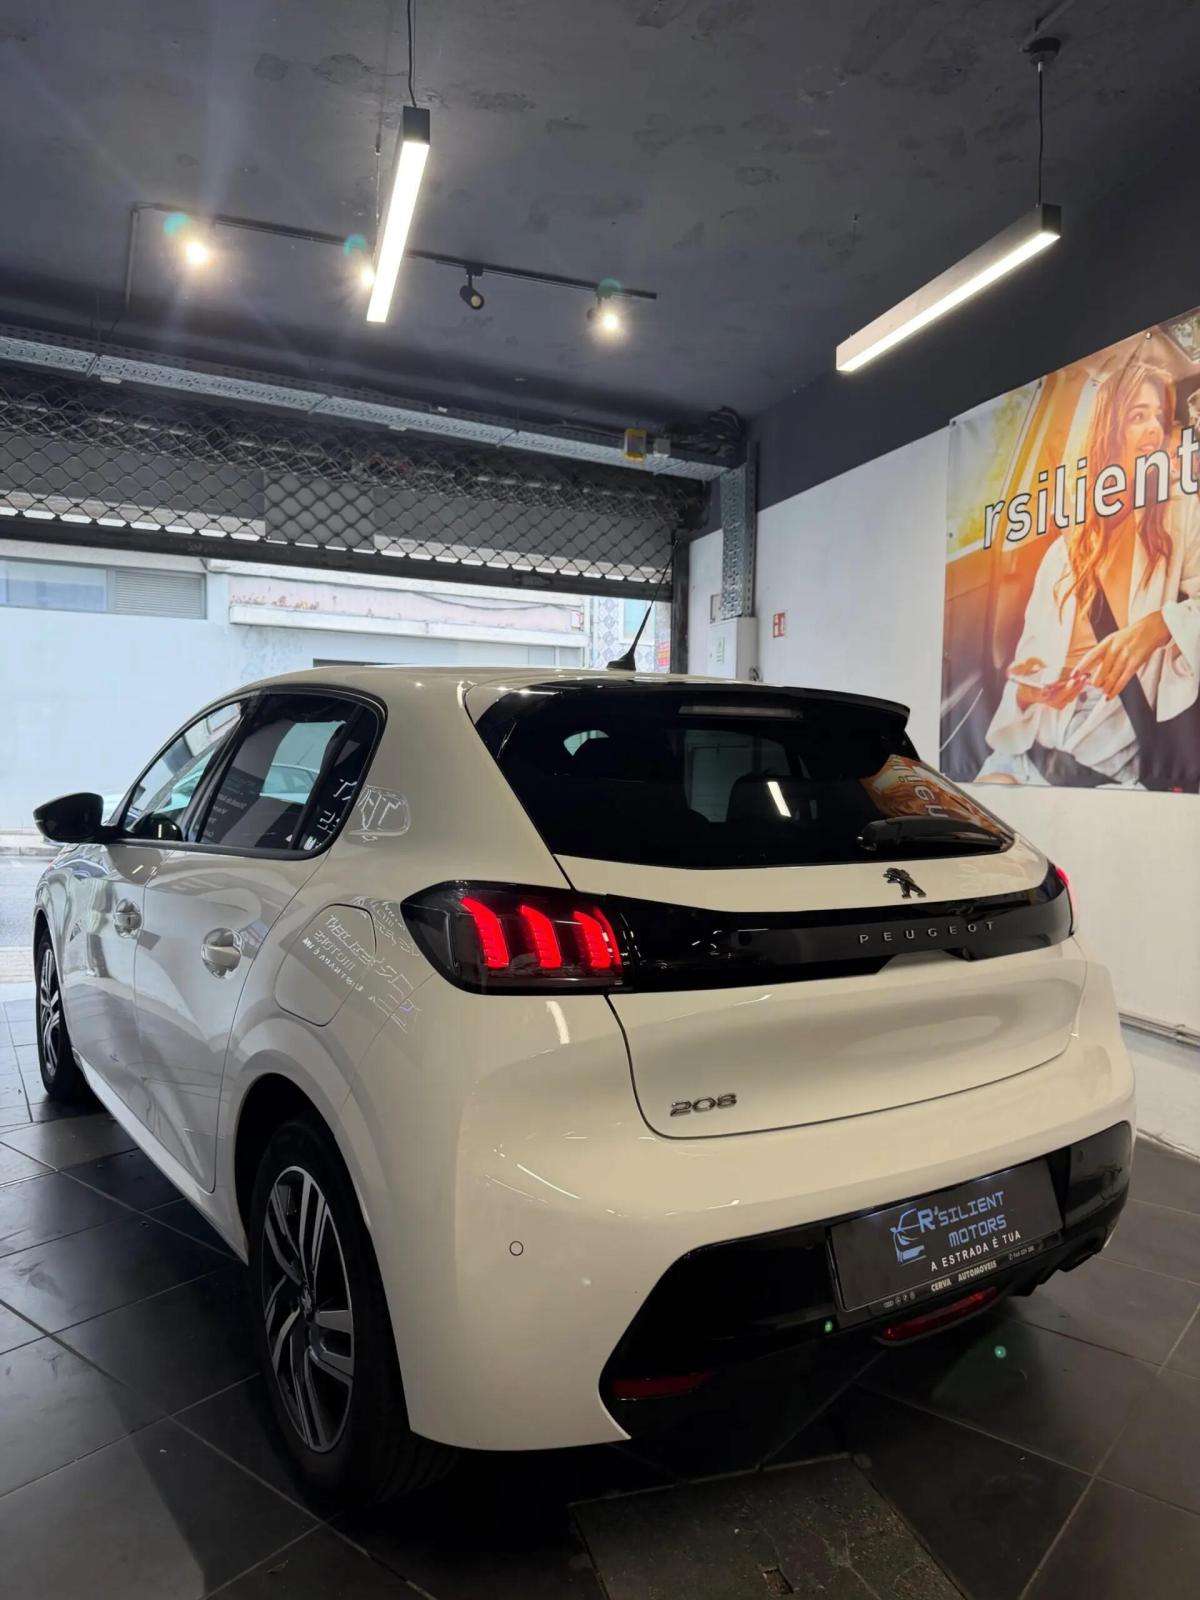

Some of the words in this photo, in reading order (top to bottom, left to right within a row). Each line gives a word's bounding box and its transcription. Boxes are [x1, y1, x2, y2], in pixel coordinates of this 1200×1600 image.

[984, 426, 1200, 549] rsilient
[859, 921, 995, 943] PEUGEOT
[670, 1093, 737, 1117] 208
[918, 1191, 1004, 1232] R'SILIENT
[949, 1214, 1007, 1247] MOTORS
[931, 1260, 938, 1271] A
[942, 1244, 989, 1267] ESTRADA
[992, 1236, 998, 1249] É
[1002, 1231, 1021, 1245] TUA
[930, 1278, 952, 1292] CERVA
